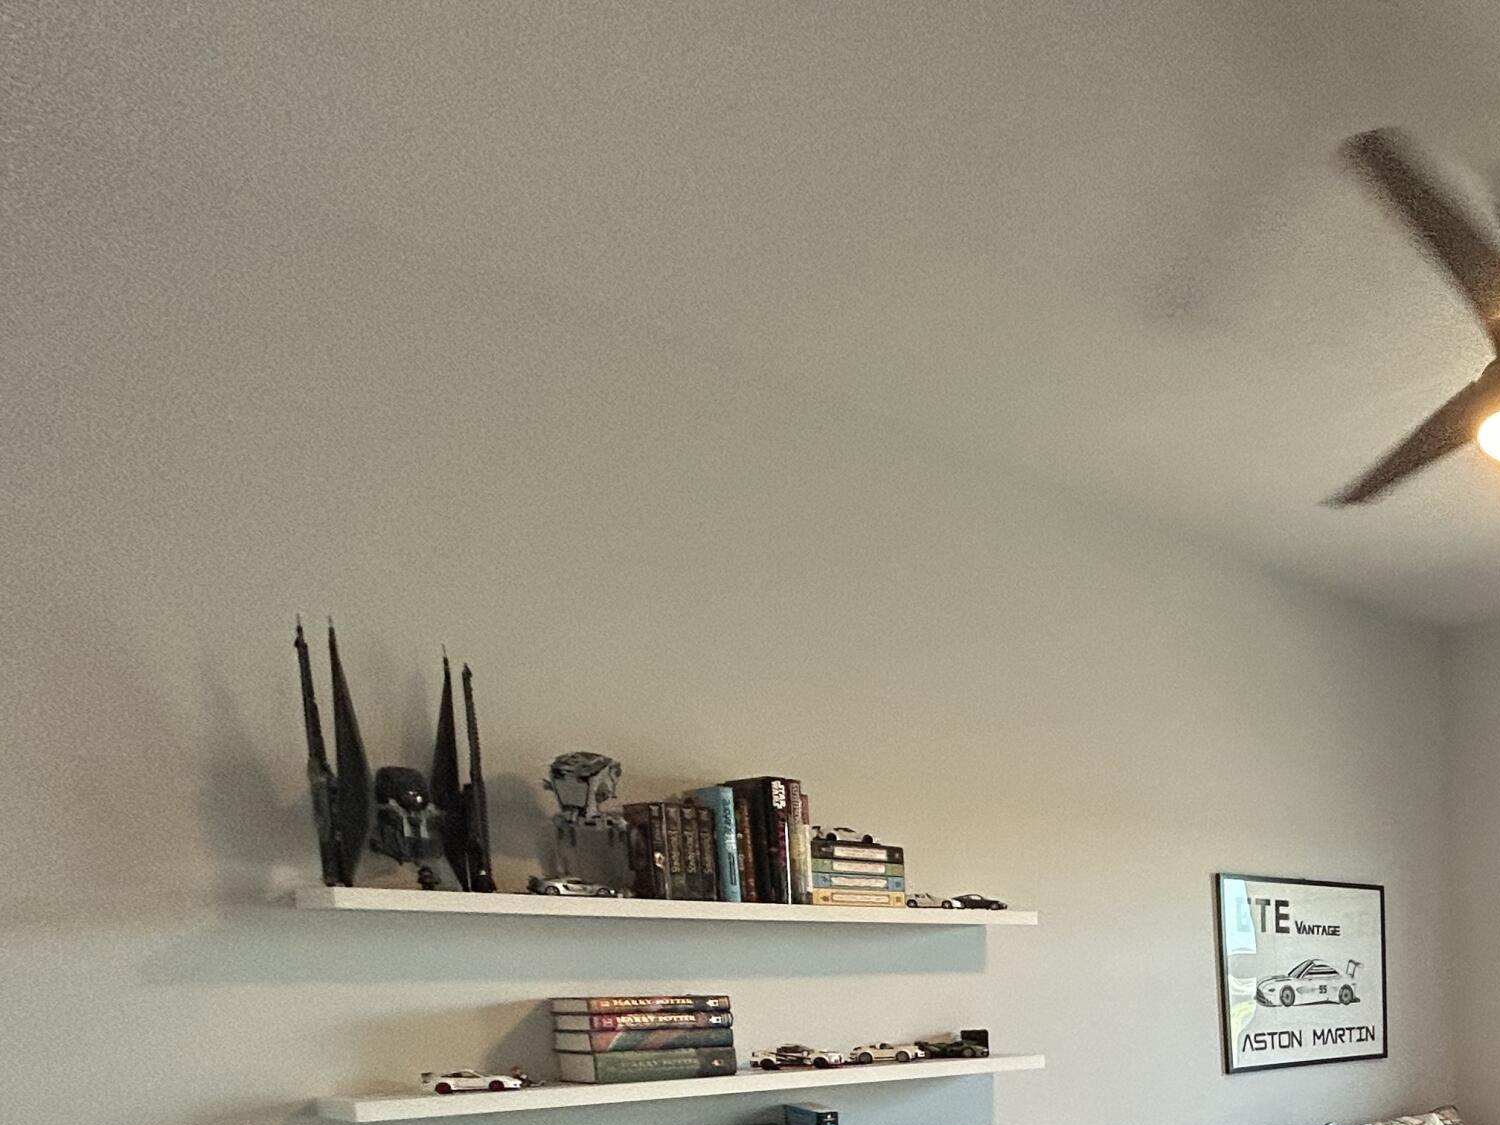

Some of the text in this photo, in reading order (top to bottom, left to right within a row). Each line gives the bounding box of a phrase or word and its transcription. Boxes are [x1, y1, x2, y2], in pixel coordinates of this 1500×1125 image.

[616, 1015, 655, 1023] HARRY
[1242, 1025, 1375, 1053] ASTON MARTIN
